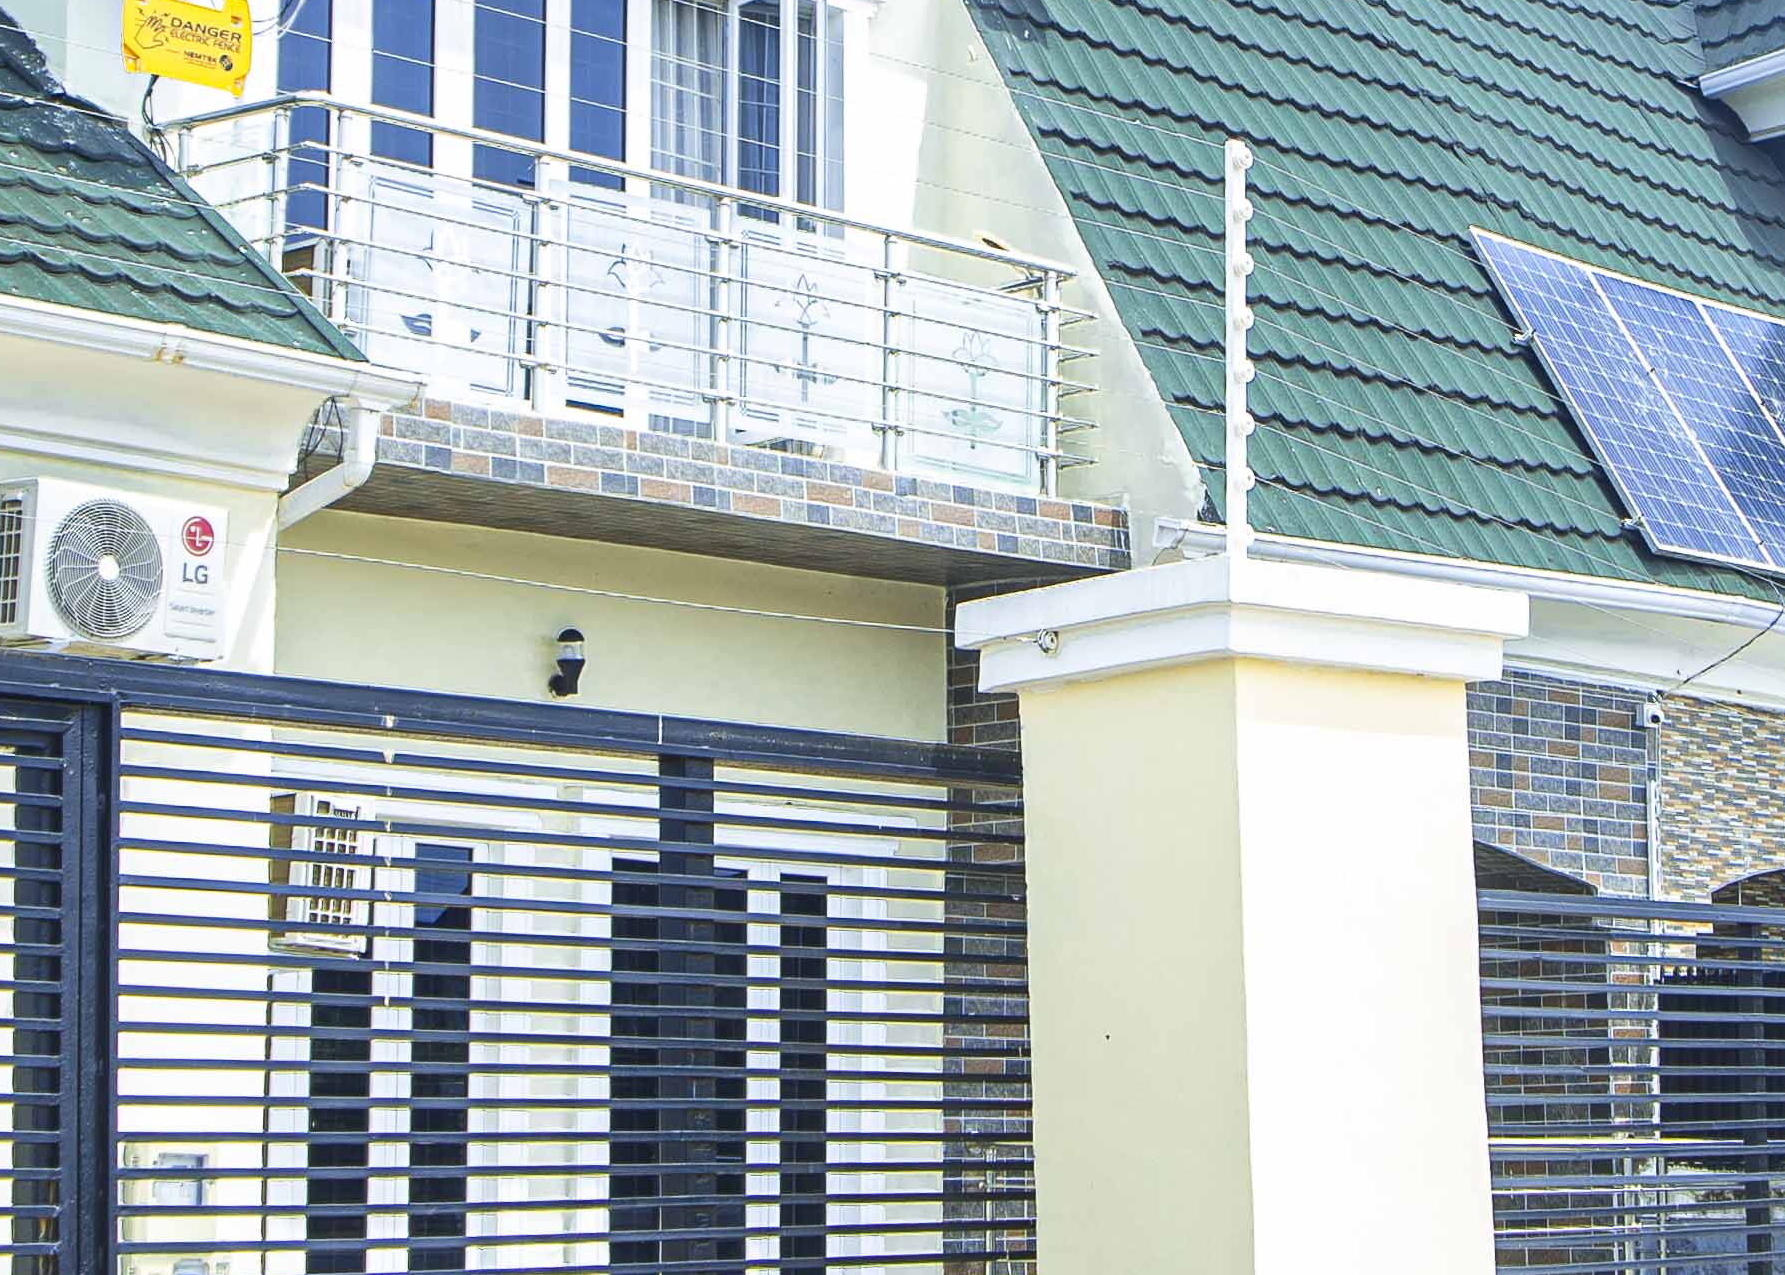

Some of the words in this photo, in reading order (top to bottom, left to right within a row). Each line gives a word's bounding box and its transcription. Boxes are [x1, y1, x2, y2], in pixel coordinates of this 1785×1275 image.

[170, 28, 210, 46] ELECTRIC
[214, 39, 242, 54] FENCE
[171, 16, 242, 42] DANGER
[182, 562, 208, 584] LG
